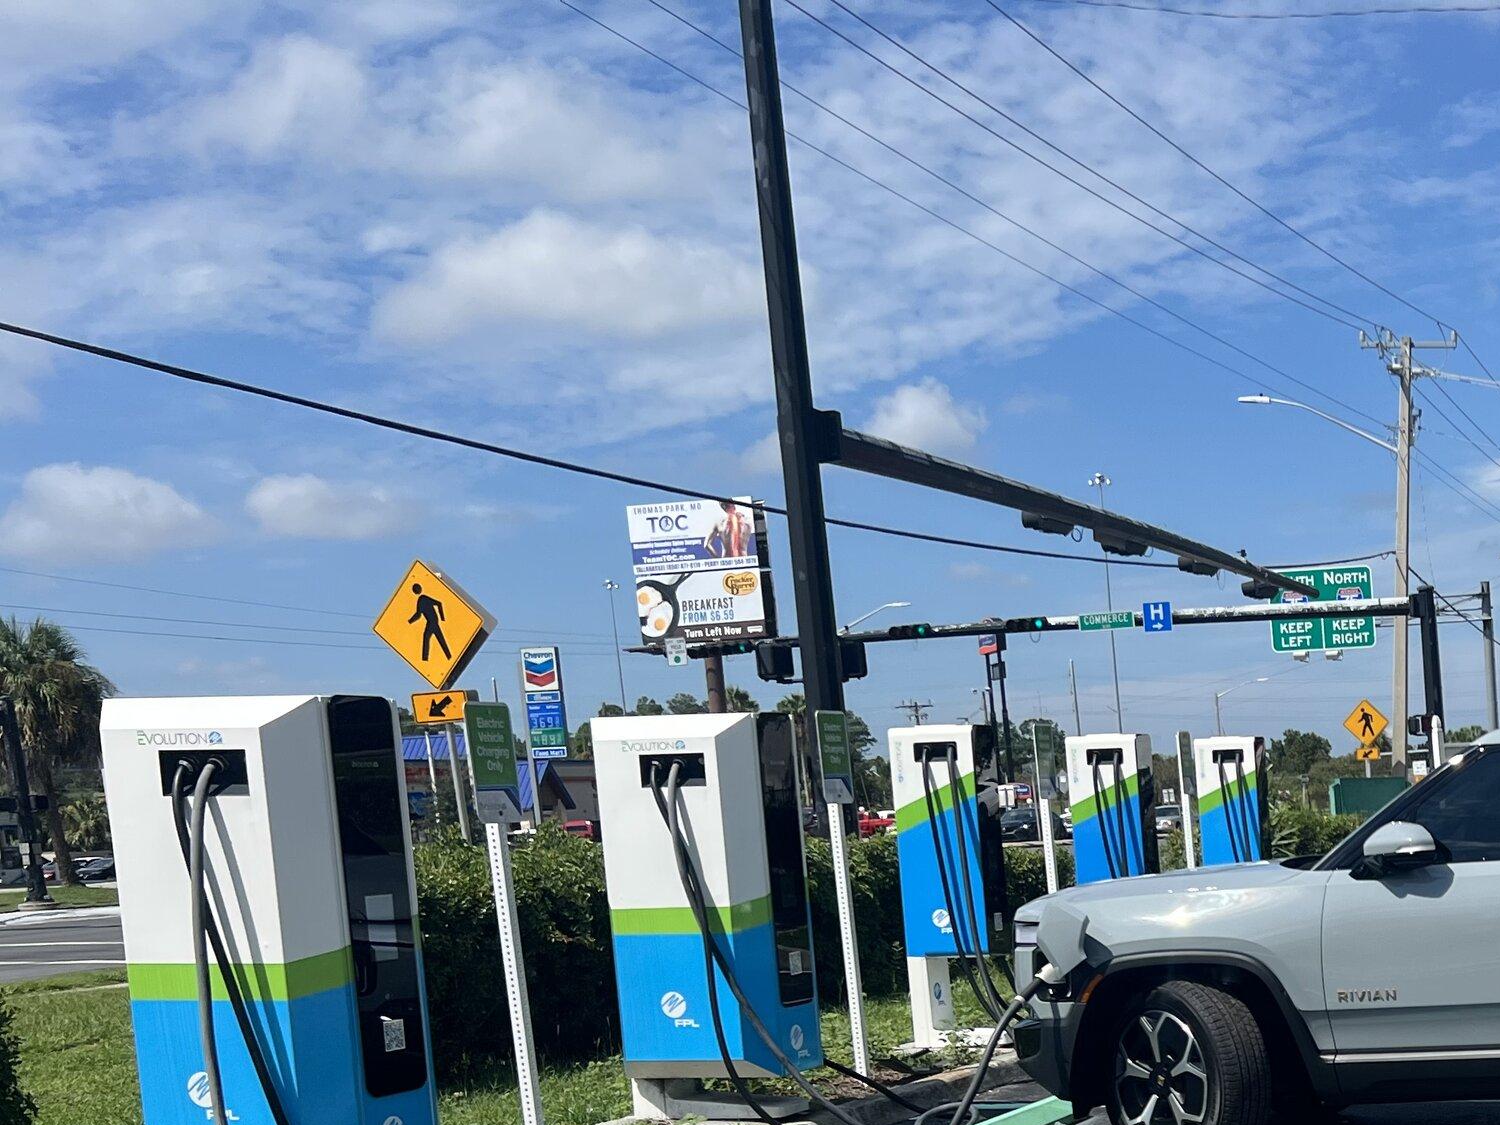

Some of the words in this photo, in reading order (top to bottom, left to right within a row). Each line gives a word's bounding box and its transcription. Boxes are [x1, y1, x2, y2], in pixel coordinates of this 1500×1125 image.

[633, 506, 663, 516] THOMAS
[646, 514, 689, 534] TOC
[642, 554, 696, 564] TeamTOC.com
[726, 576, 754, 588] Cracker
[1323, 571, 1368, 585] NORTH
[731, 582, 754, 595] Barrel
[682, 598, 734, 612] BREAKFAST
[682, 612, 708, 624] FROM
[710, 610, 735, 621] $6.59
[1150, 604, 1164, 620] H
[1084, 612, 1128, 626] COMMERCE
[1332, 618, 1366, 631] KEEP
[684, 628, 704, 638] Turn
[705, 626, 722, 636] Left
[724, 626, 742, 636] Now
[1280, 622, 1313, 634] KEEP
[1281, 636, 1312, 648] LEFT
[1332, 632, 1370, 644] RIGHT
[476, 718, 504, 728] Electric
[137, 730, 208, 746] EVOLUTION
[478, 732, 504, 743] Vehicle
[621, 740, 674, 752] EVOLUTION
[476, 746, 510, 759] Charging
[487, 760, 504, 773] Only
[1336, 989, 1398, 1004] RIVIAN
[674, 1018, 700, 1028] FPL
[206, 1109, 240, 1121] FL
